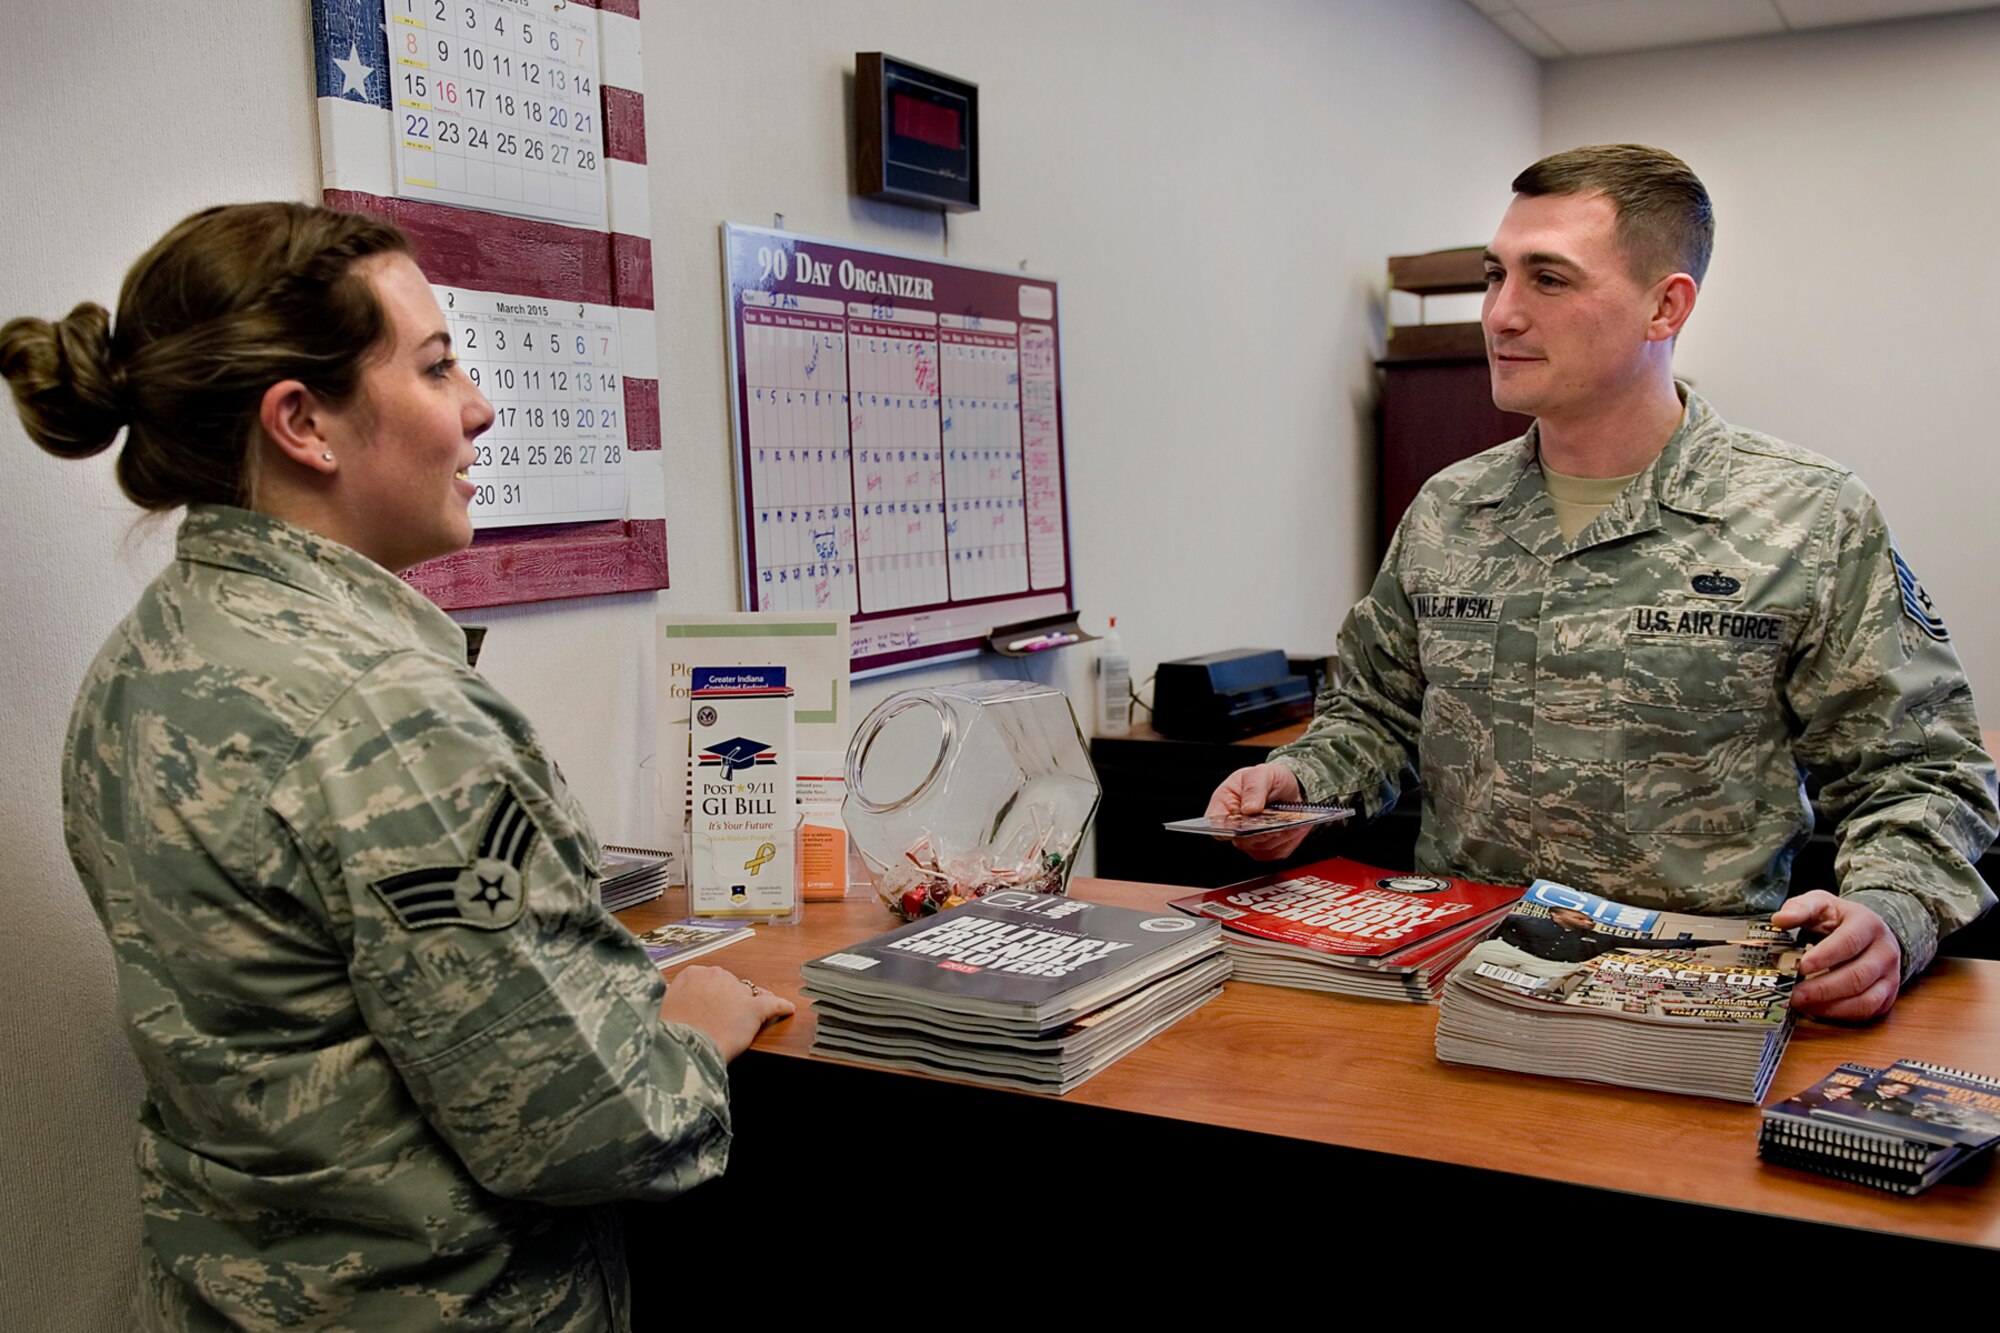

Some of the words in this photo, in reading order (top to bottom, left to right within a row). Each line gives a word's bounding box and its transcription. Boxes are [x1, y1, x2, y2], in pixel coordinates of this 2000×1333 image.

[436, 0, 446, 20] 2
[465, 8, 476, 29] 3
[494, 16, 504, 37] 4
[522, 24, 532, 44] 5
[550, 32, 560, 51] 6
[576, 38, 584, 57] 7
[406, 32, 418, 54] 8
[438, 40, 449, 62] 9
[464, 47, 484, 70] 10
[492, 54, 510, 77] 11
[521, 62, 540, 84] 12
[548, 68, 566, 90] 13
[574, 75, 591, 96] 14
[404, 73, 426, 97] 15
[436, 80, 458, 104] 16
[466, 88, 486, 110] 17
[496, 94, 515, 116] 18
[523, 100, 542, 122] 18
[549, 106, 568, 128] 20
[574, 112, 592, 134] 21
[406, 114, 429, 138] 22
[438, 120, 460, 144] 23
[468, 126, 489, 150] 24
[497, 132, 518, 155] 25
[524, 138, 544, 160] 26
[551, 144, 569, 165] 27
[576, 150, 596, 170] 28
[758, 246, 787, 282] 90
[496, 302, 525, 315] March
[528, 304, 549, 316] 2015
[768, 291, 799, 308] JAN
[466, 328, 477, 348] 2
[495, 330, 506, 350] 3
[524, 332, 533, 352] 4
[551, 334, 560, 353] 5
[576, 336, 586, 355] 6
[600, 338, 608, 356] 7
[470, 368, 480, 388] 9
[494, 368, 514, 390] 10
[522, 370, 540, 390] 11
[550, 372, 568, 391] 12
[576, 372, 592, 392] 13
[600, 374, 616, 392] 14
[498, 408, 516, 428] 17
[526, 408, 544, 428] 18
[552, 408, 570, 428] 19
[576, 409, 594, 428] 20
[601, 410, 617, 428] 21
[474, 446, 492, 466] 23
[500, 446, 520, 466] 24
[528, 446, 547, 465] 25
[554, 446, 572, 464] 26
[579, 446, 596, 464] 27
[604, 446, 621, 464] 28
[475, 484, 495, 506] 30
[504, 484, 521, 504] 31
[1637, 611, 1672, 632] U.S.
[1677, 612, 1712, 635] AIR
[1720, 615, 1781, 640] FORCE
[708, 676, 736, 684] Greater
[738, 674, 764, 682] Indiana
[747, 782, 774, 794] 9/11
[702, 798, 727, 816] GI
[736, 798, 776, 814] BILL
[708, 822, 720, 830] It's
[723, 822, 743, 830] Your
[745, 821, 773, 830] Future
[1276, 879, 1460, 920] MILITARY
[1300, 875, 1358, 891] 2015
[1358, 889, 1434, 905] GUIDE
[1441, 901, 1474, 912] TO
[1226, 894, 1414, 941] SCHOOLS
[1252, 886, 1442, 932] FRIENDLY
[920, 926, 1108, 968] FRIENDLY
[942, 916, 1134, 954] MILITARY
[886, 936, 1073, 977] EMPLOYERS
[1605, 954, 1716, 972] BEYOND
[1726, 966, 1780, 976] THE
[1600, 960, 1778, 987] REACTOR
